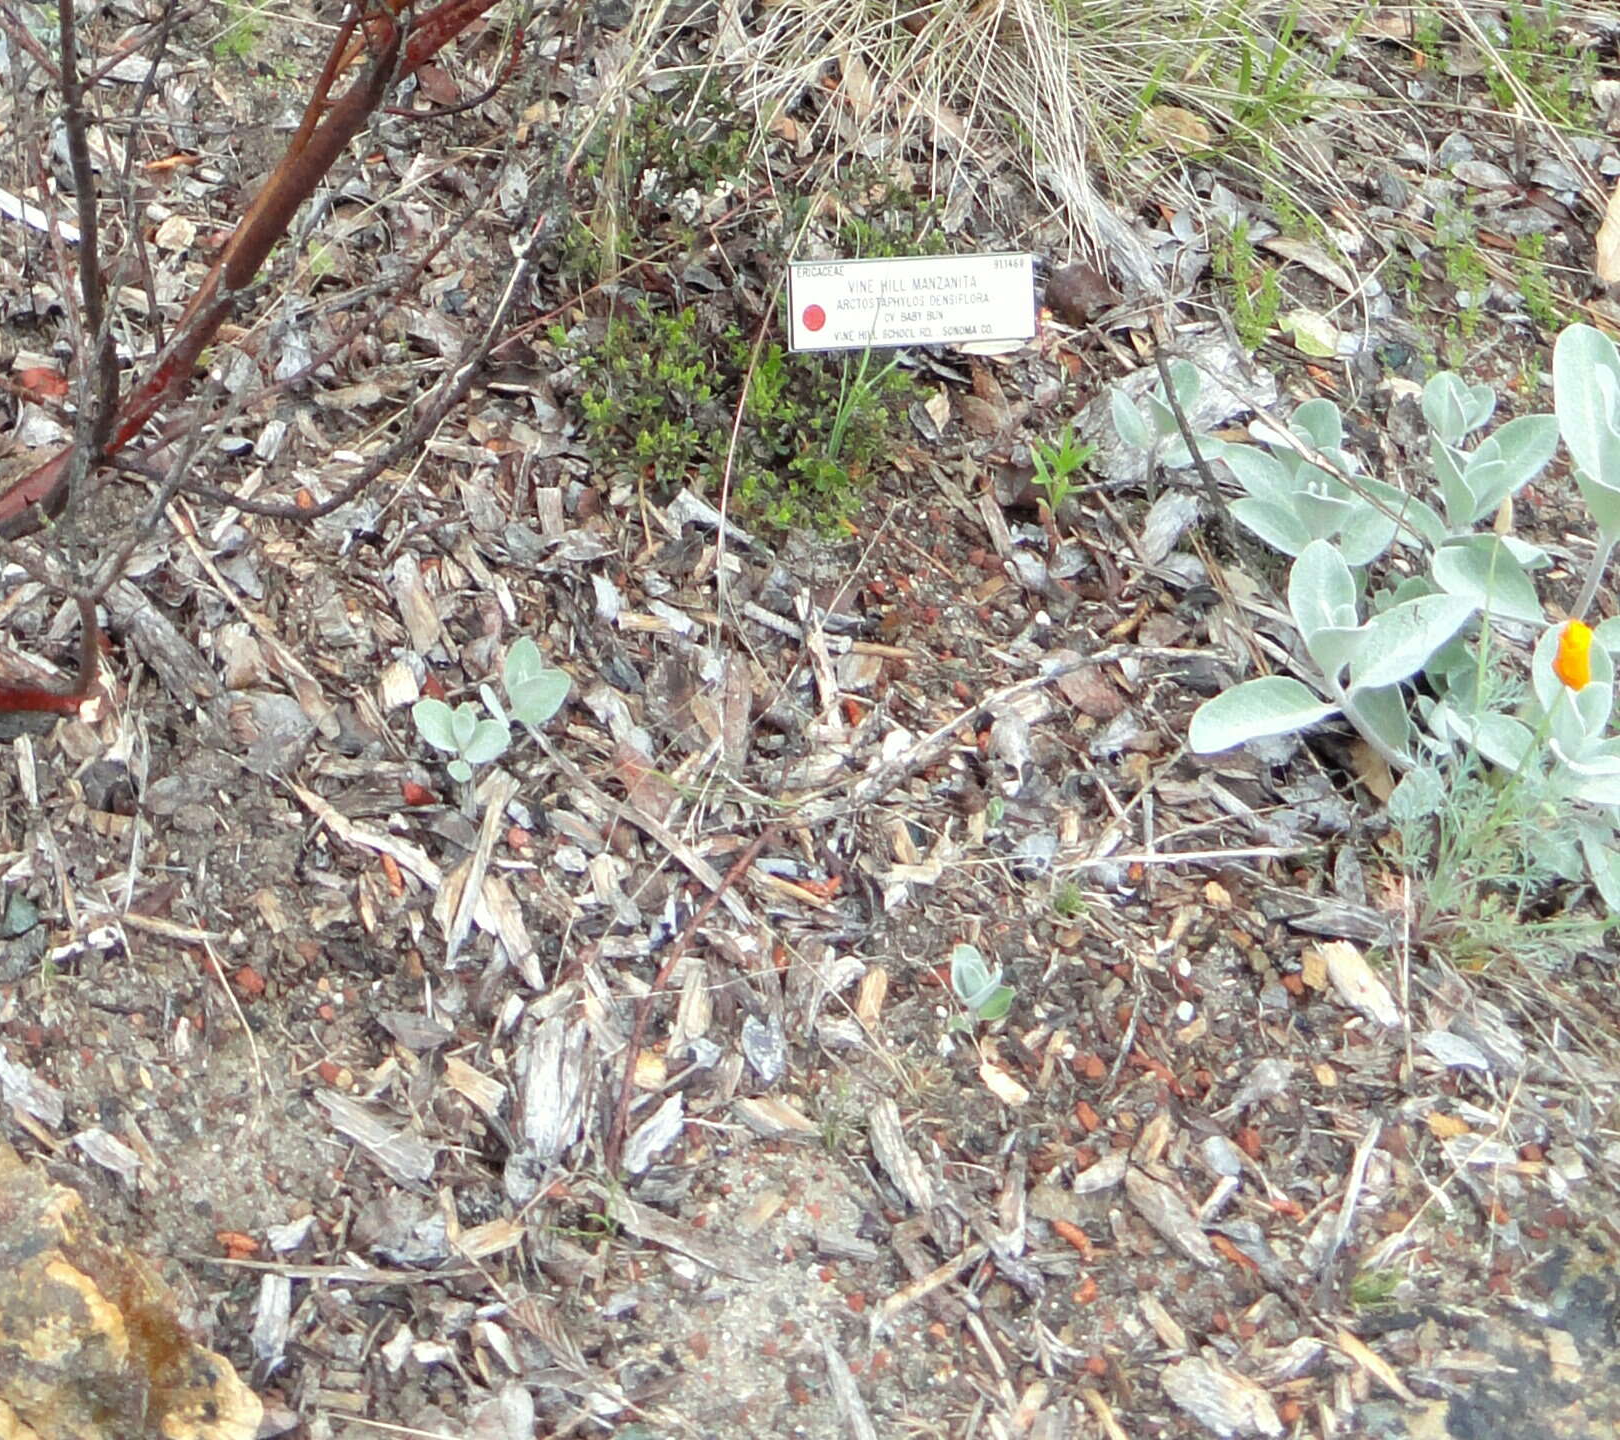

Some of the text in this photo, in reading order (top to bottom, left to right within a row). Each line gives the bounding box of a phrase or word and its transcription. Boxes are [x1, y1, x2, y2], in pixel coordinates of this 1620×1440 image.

[796, 266, 845, 278] ERICACEAE
[848, 275, 977, 293] VINE HILL MANZANITA
[836, 292, 989, 310] ARCTOSTAPHYLOS DENSIFLORA
[834, 330, 855, 341] VINE
[858, 330, 878, 341] HILL
[882, 328, 916, 339] SCHOOL
[942, 325, 977, 336] SONOMA
